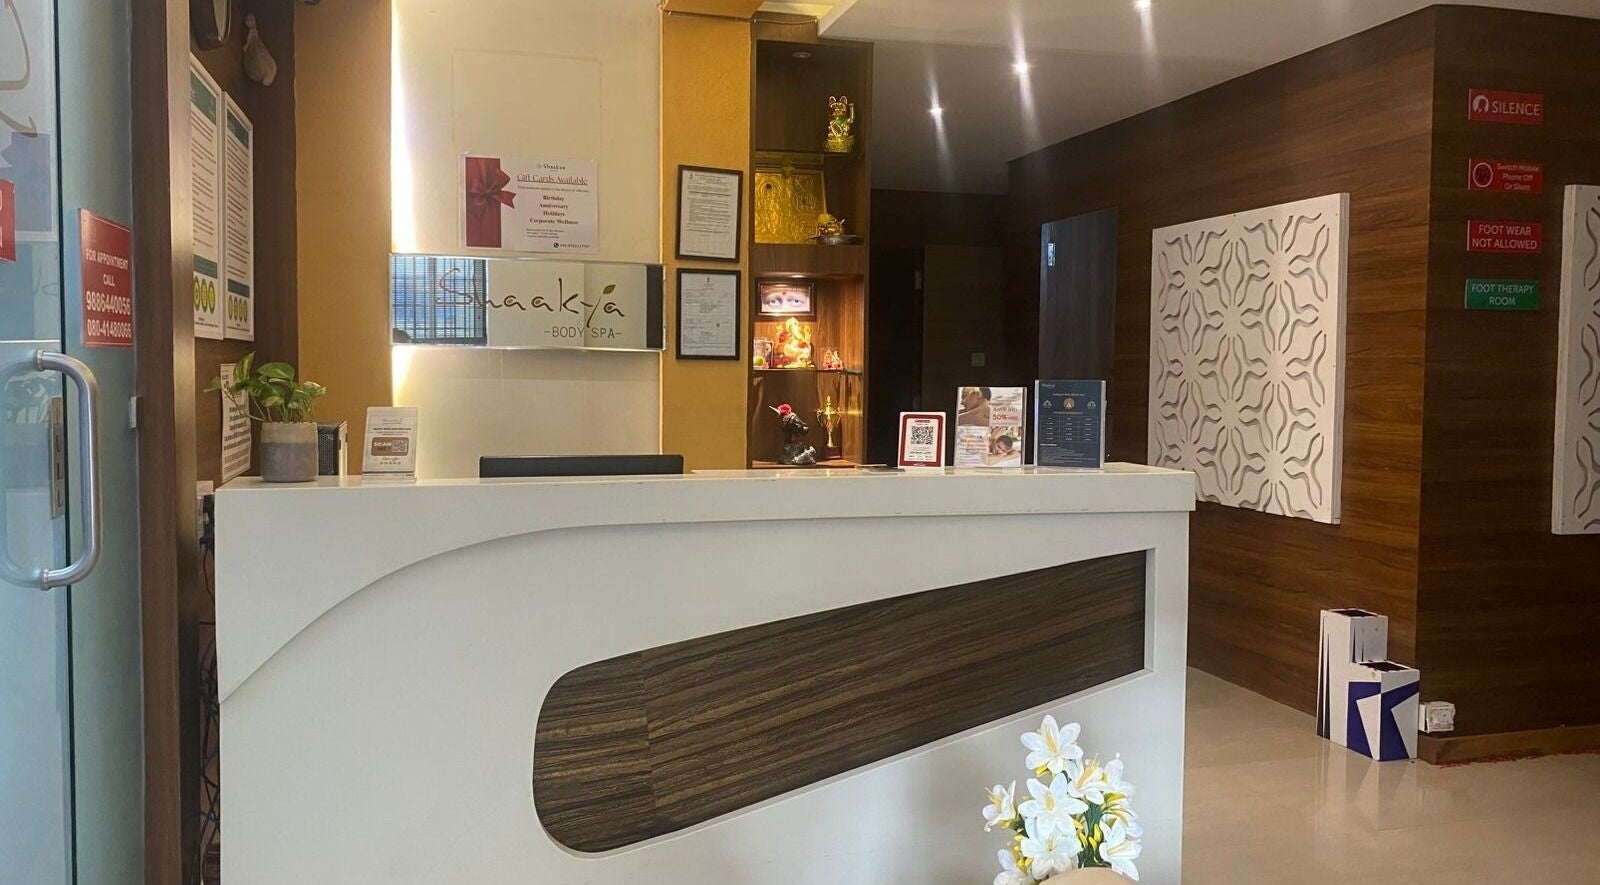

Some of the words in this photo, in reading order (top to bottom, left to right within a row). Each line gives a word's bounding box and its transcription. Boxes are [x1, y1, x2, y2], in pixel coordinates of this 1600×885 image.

[1492, 101, 1540, 116] SILENCE
[517, 173, 530, 182] Gift
[532, 174, 555, 183] Cards
[557, 175, 588, 185] Available
[1502, 173, 1521, 181] Phone
[1479, 224, 1504, 235] FOOT
[1506, 225, 1532, 236] WEAR
[1472, 238, 1492, 248] NOT
[1494, 239, 1537, 250] ALLOWED
[86, 248, 97, 262] FOR
[97, 250, 129, 271] APPOINTMENT
[103, 273, 115, 287] CALL
[1471, 283, 1496, 293] FOOT
[1497, 284, 1535, 294] THERAPY
[86, 290, 131, 316] 9886440056
[1489, 296, 1516, 306] ROOM
[992, 413, 1008, 421] 50%
